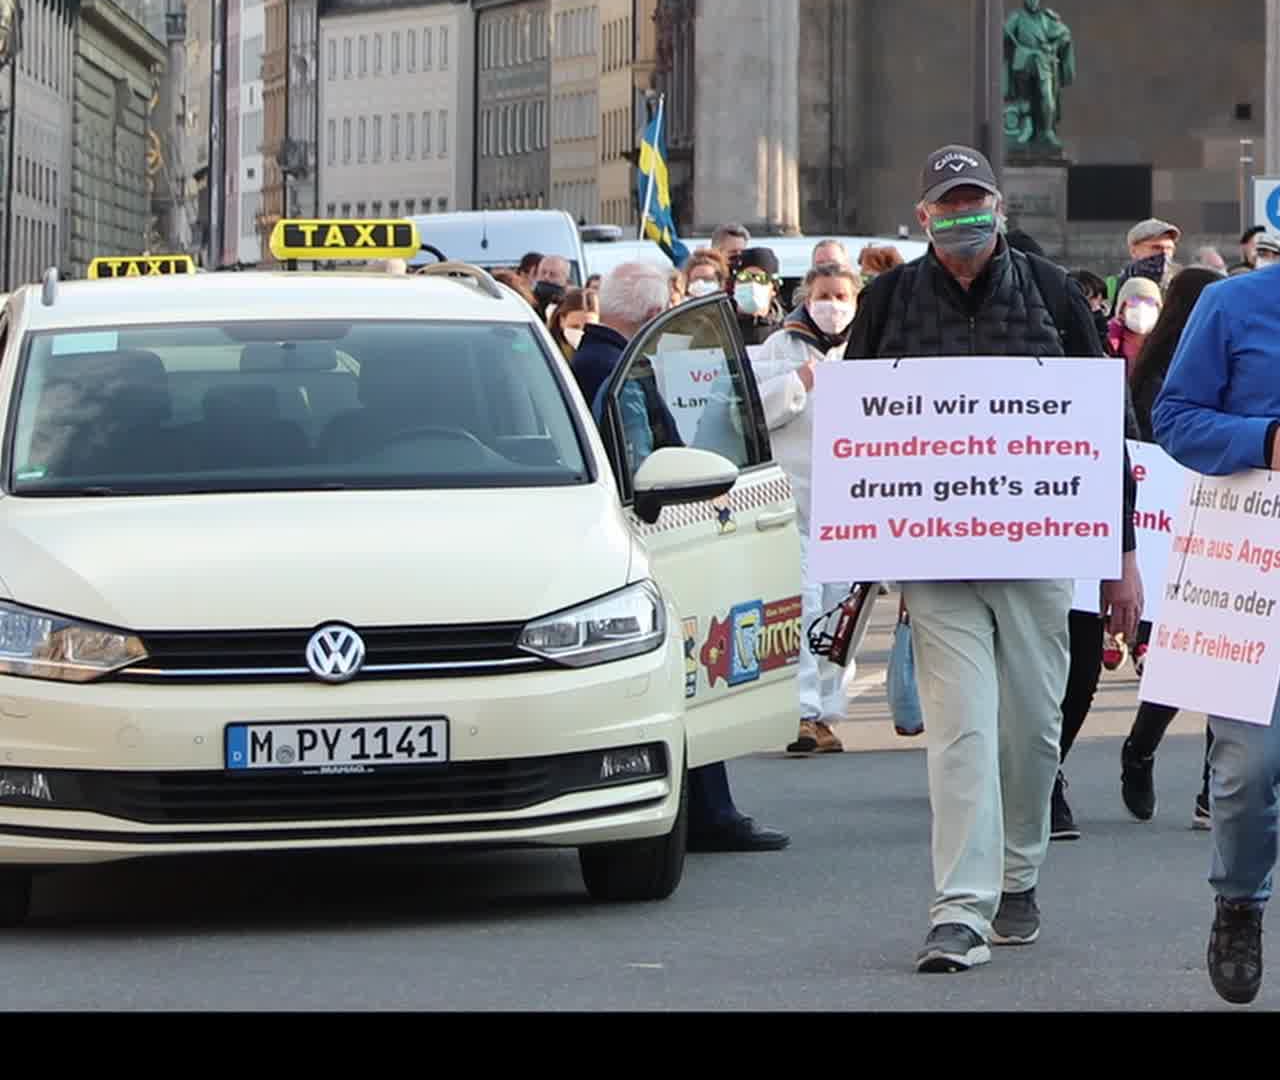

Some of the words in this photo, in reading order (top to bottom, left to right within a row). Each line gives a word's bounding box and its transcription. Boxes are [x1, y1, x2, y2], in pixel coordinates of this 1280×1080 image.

[300, 224, 396, 248] TAXI
[109, 261, 176, 278] TAXI
[862, 395, 923, 416] Weil
[934, 394, 979, 415] wir
[989, 397, 1072, 415] unser
[833, 436, 997, 458] Grundrecht
[1007, 435, 1100, 460] ehren,
[850, 478, 923, 498] drum
[1034, 476, 1081, 497] auf
[1219, 488, 1239, 512] du
[820, 523, 878, 541] zum
[888, 518, 1110, 542] Volksbegehren
[1206, 539, 1233, 561] aus
[1182, 580, 1229, 609] Corona
[1234, 589, 1276, 617] oder
[1193, 631, 1266, 665] Freiheit?
[250, 730, 273, 763] M
[351, 725, 438, 759] 1141
